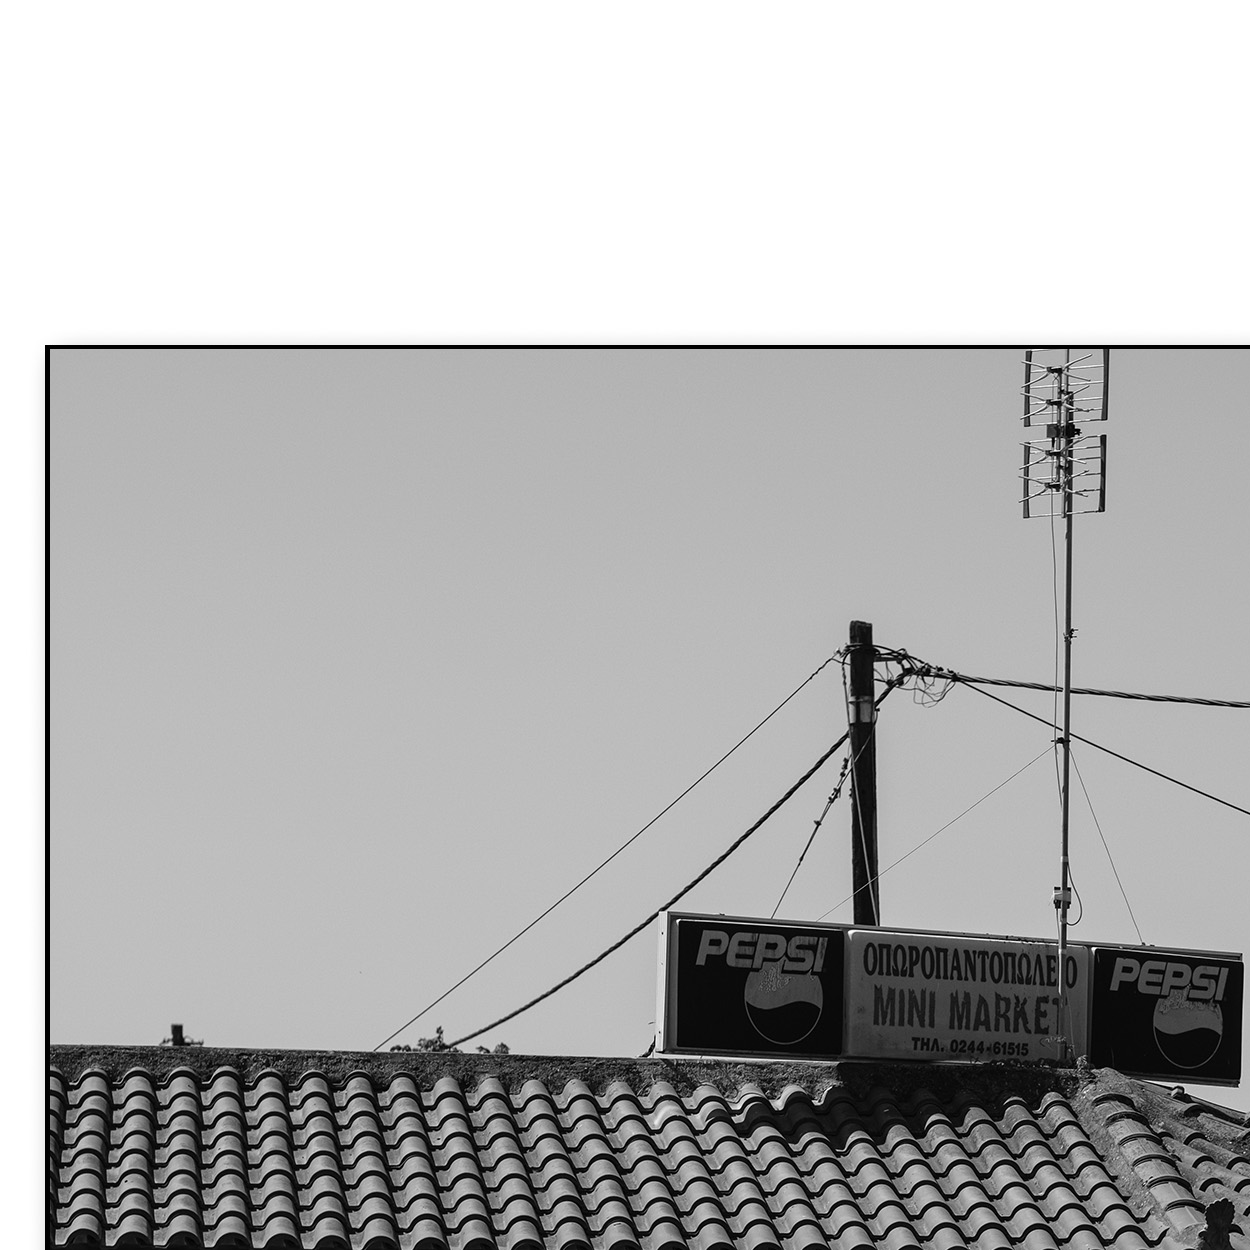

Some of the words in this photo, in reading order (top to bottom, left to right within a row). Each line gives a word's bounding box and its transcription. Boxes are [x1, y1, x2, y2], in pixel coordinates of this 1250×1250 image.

[695, 930, 829, 972] PEPSI
[863, 942, 1077, 988] ΟΠΩΡΟΠΑΝΤΟΠΩΛΕΟ
[1109, 957, 1229, 1001] PEPSI
[873, 984, 935, 1028] MINI
[948, 989, 1066, 1034] MARKET
[911, 1037, 944, 1052] ΤΗΛ.
